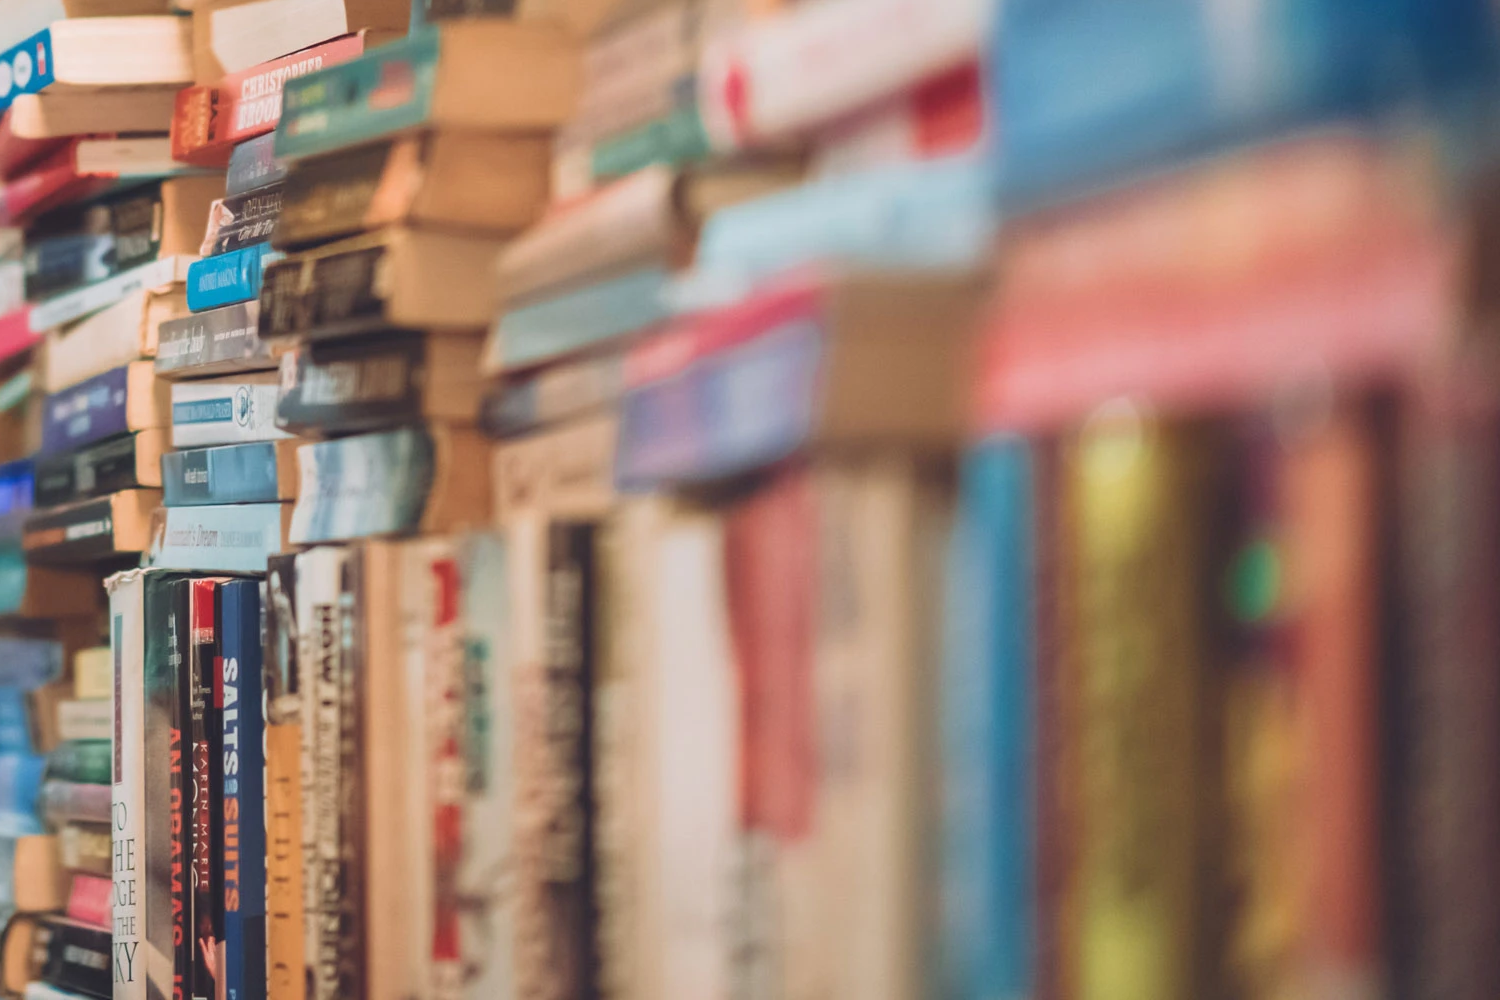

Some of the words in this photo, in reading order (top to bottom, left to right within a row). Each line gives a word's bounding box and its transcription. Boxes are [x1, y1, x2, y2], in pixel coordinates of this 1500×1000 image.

[238, 96, 282, 131] BROOK
[223, 657, 238, 776] SALTS
[170, 727, 182, 773] AN
[200, 744, 208, 810] KAREN
[170, 787, 183, 946] OBAMA'S
[200, 823, 209, 887] MARIE
[224, 797, 239, 913] SUITS
[113, 941, 140, 985] KY
